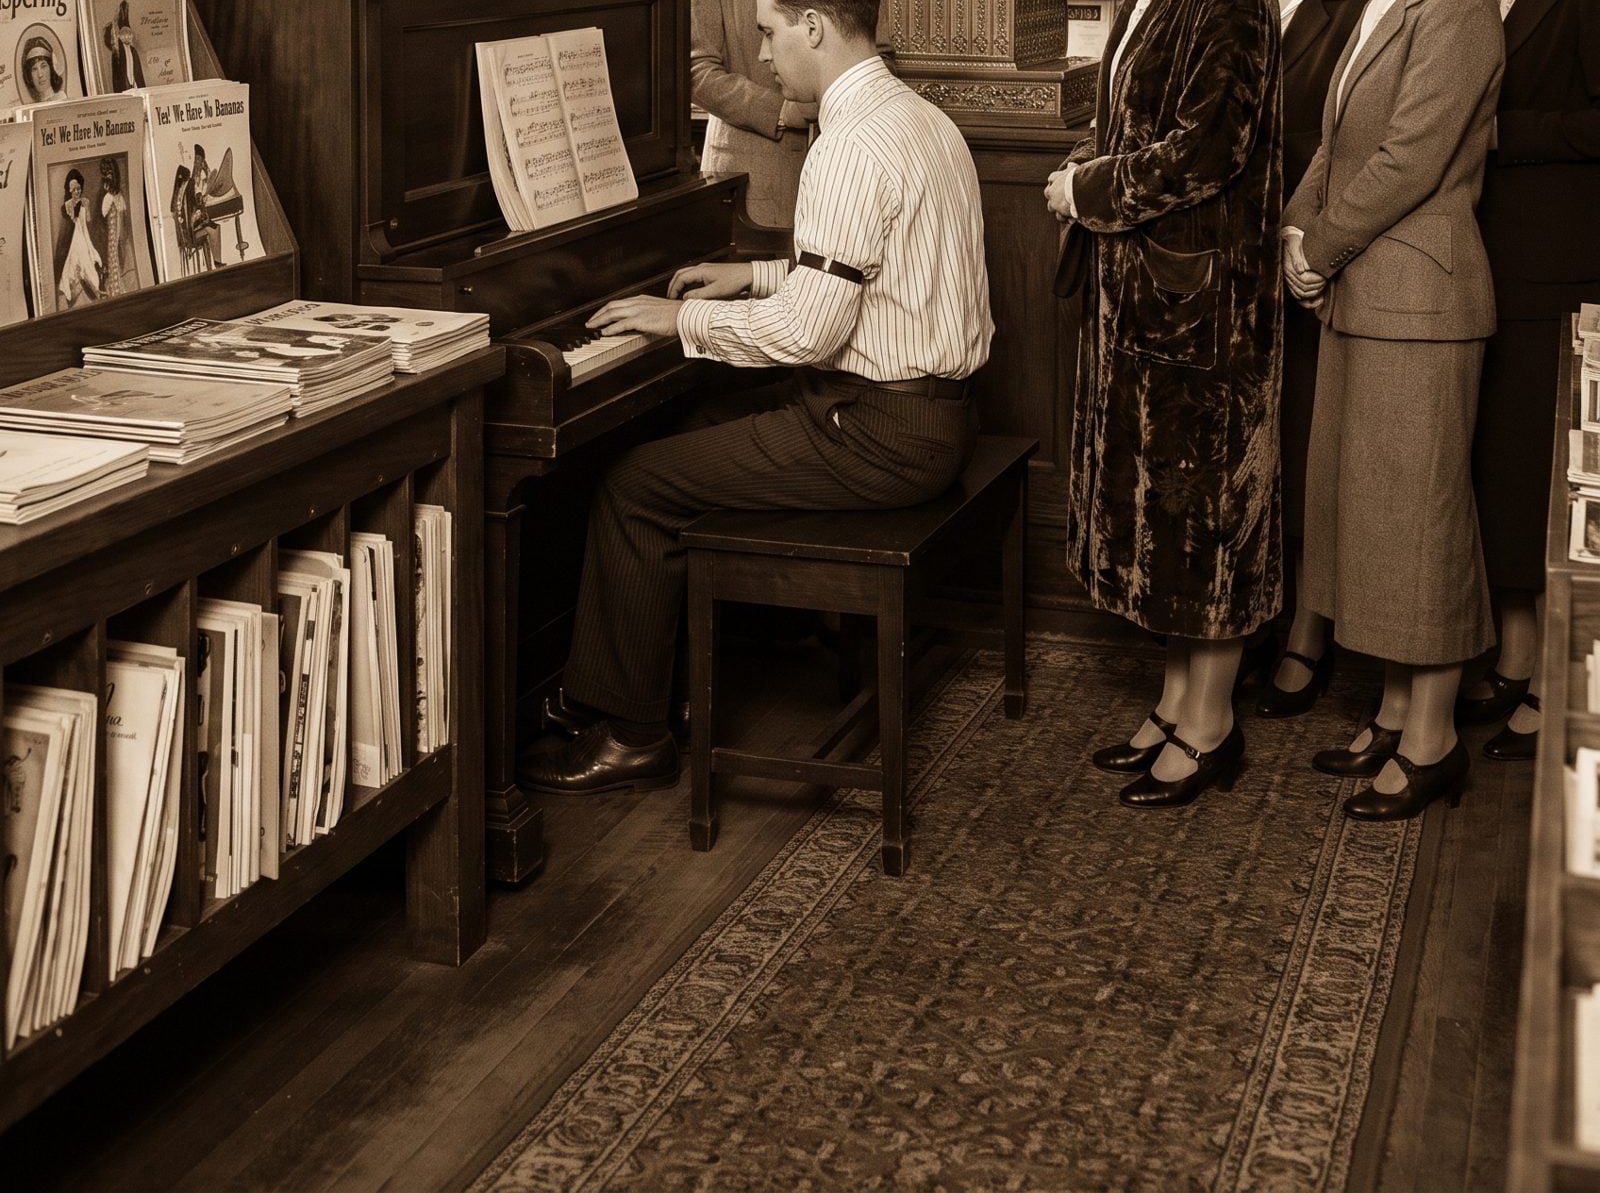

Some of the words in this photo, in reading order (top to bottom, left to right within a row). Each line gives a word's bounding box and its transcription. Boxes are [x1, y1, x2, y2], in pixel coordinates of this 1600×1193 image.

[155, 106, 172, 126] Yes!
[172, 104, 185, 123] We
[203, 100, 213, 119] No
[215, 98, 245, 117] Bananas
[41, 127, 56, 147] Yes!
[59, 125, 71, 144] We
[73, 123, 92, 142] Have
[93, 120, 104, 139] No
